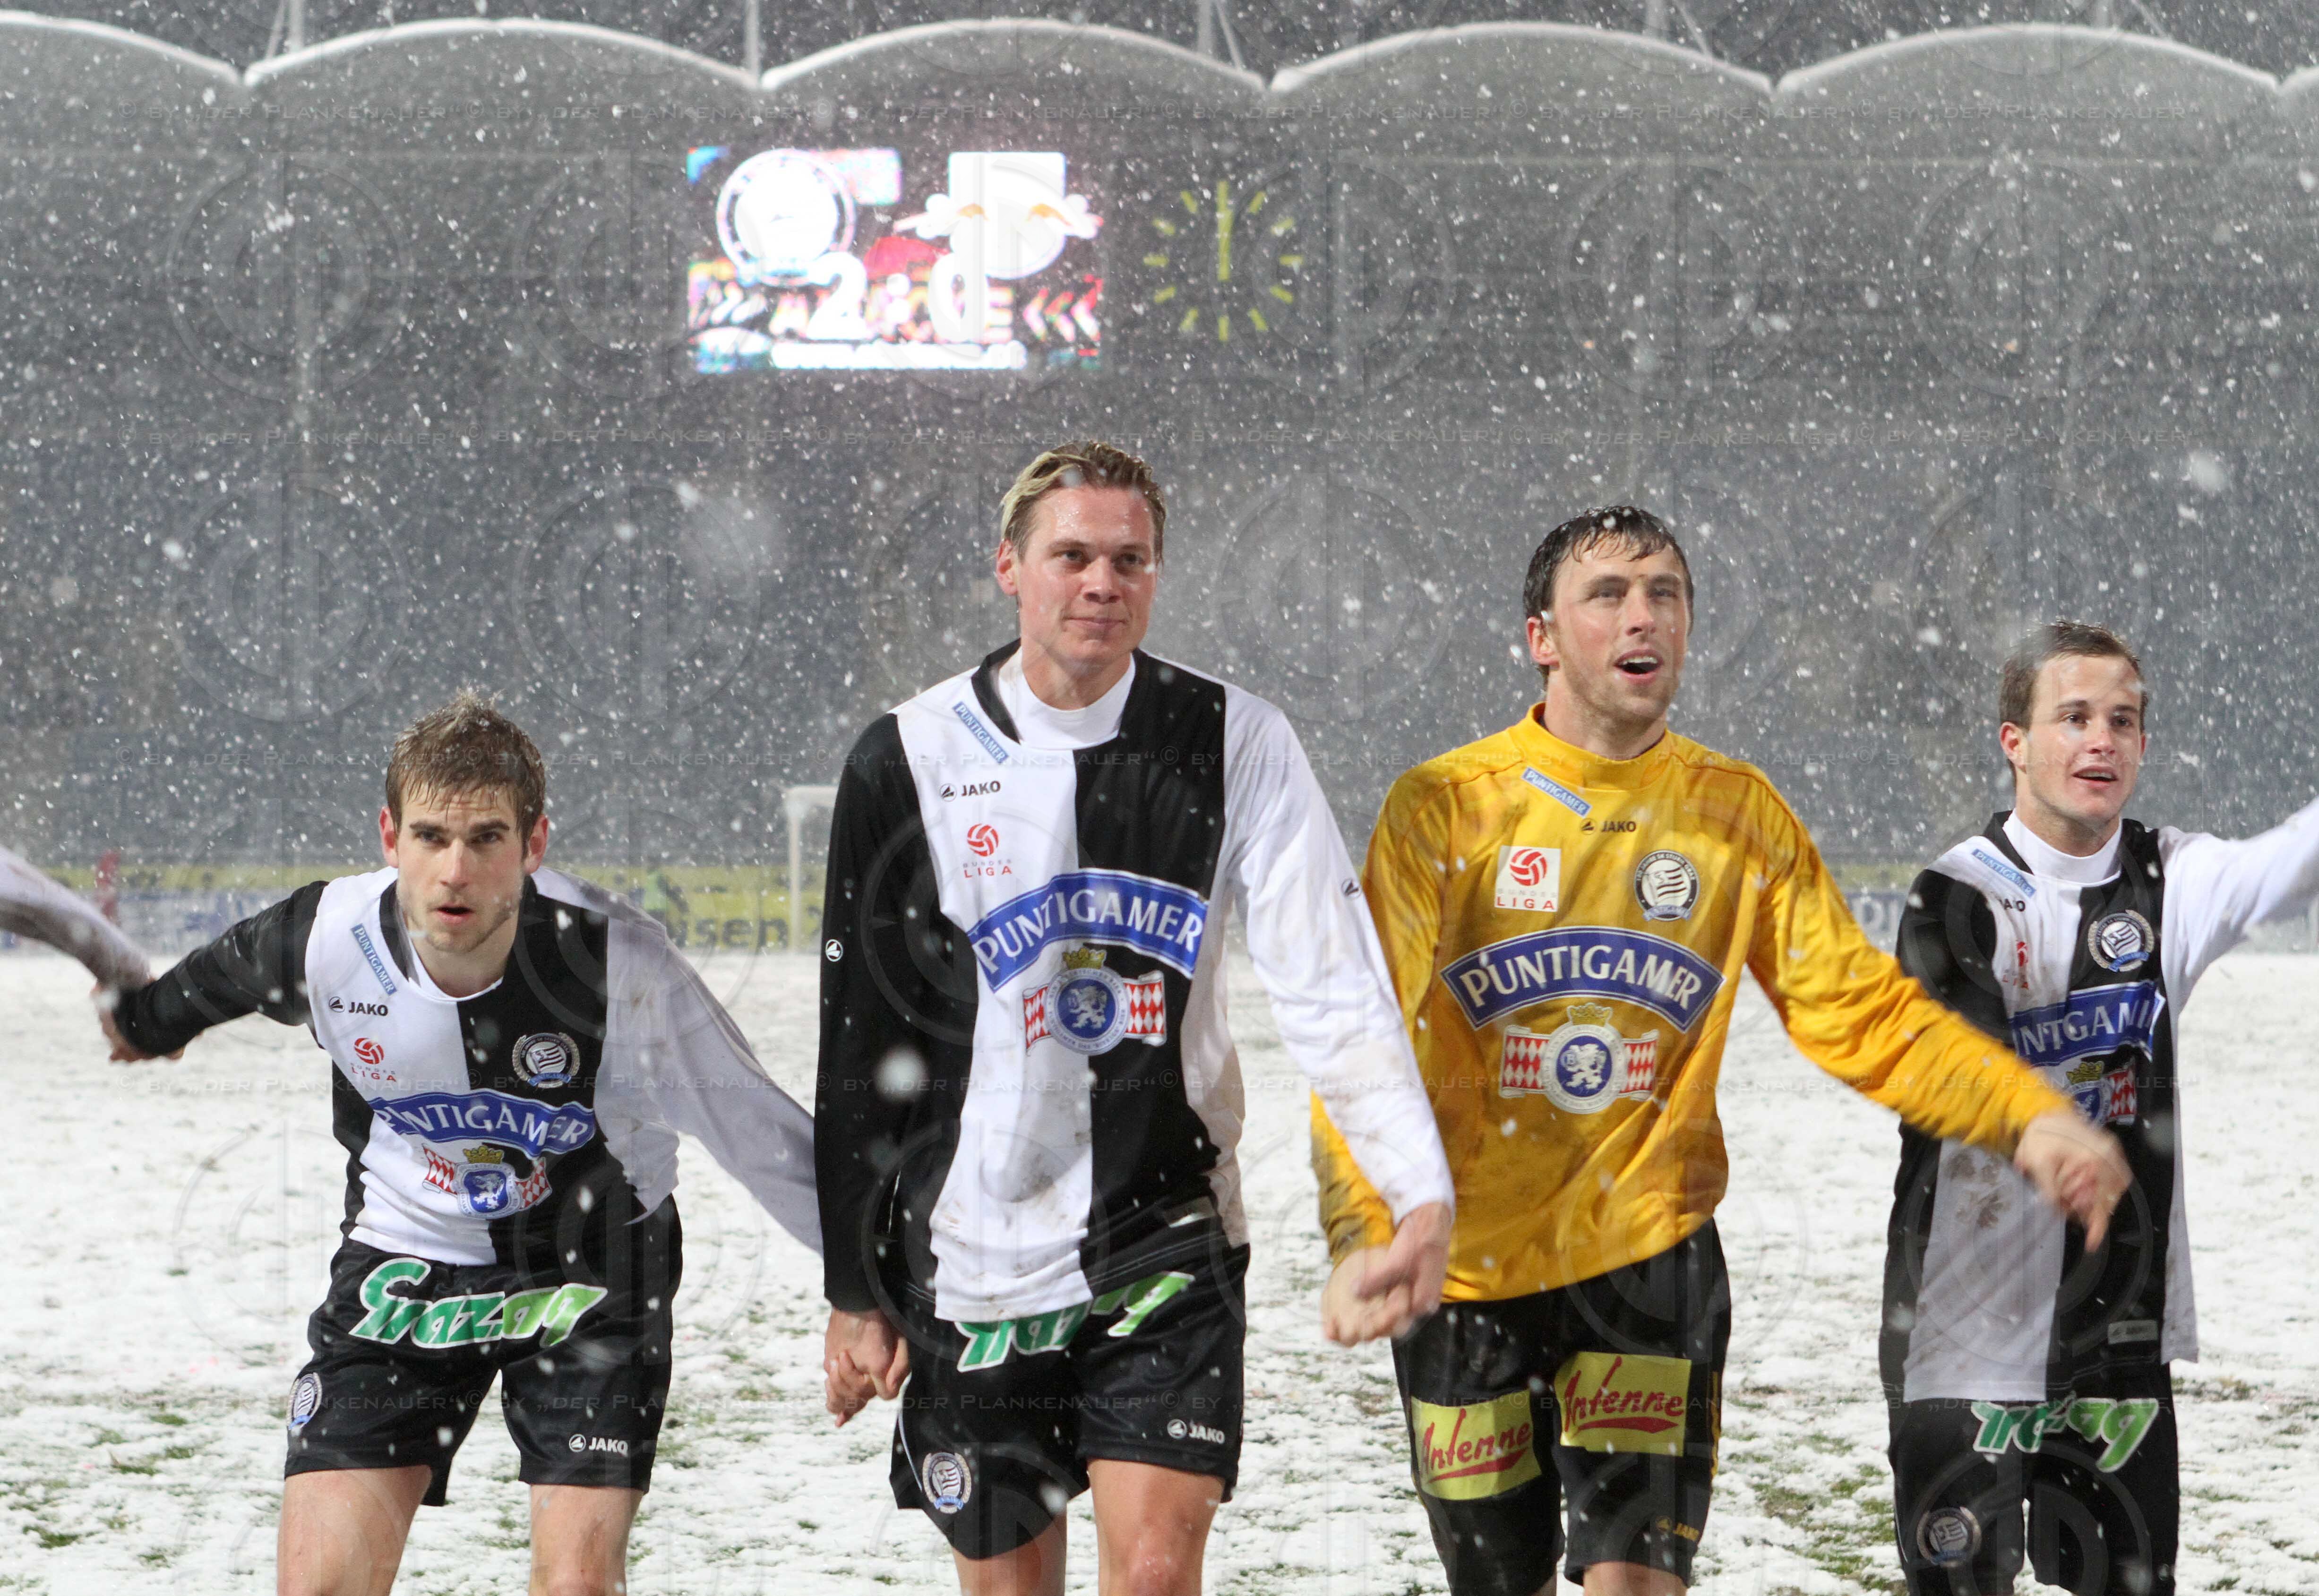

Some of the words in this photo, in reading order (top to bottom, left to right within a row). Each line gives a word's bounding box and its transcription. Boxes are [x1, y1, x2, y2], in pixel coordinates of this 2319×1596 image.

[955, 703, 1007, 763] PUNTIGAMER
[961, 781, 1001, 797] JAKO
[1526, 770, 1588, 815] PUNTIGAMER
[1601, 820, 1637, 833] JAKO
[964, 865, 1013, 878] LIGA
[1496, 896, 1555, 910] LIGA
[972, 889, 1203, 973] PUNTIGAMER
[355, 927, 395, 993] PUNTIGAMER
[1459, 944, 1701, 1010] PUNTIGAMER
[349, 1002, 388, 1016] JAKO
[351, 1066, 396, 1082] LIGA
[1564, 1356, 1685, 1433] Antenne
[1189, 1424, 1225, 1444] JAKO
[1422, 1408, 1533, 1475] Antenne
[588, 1436, 628, 1455] JAKO
